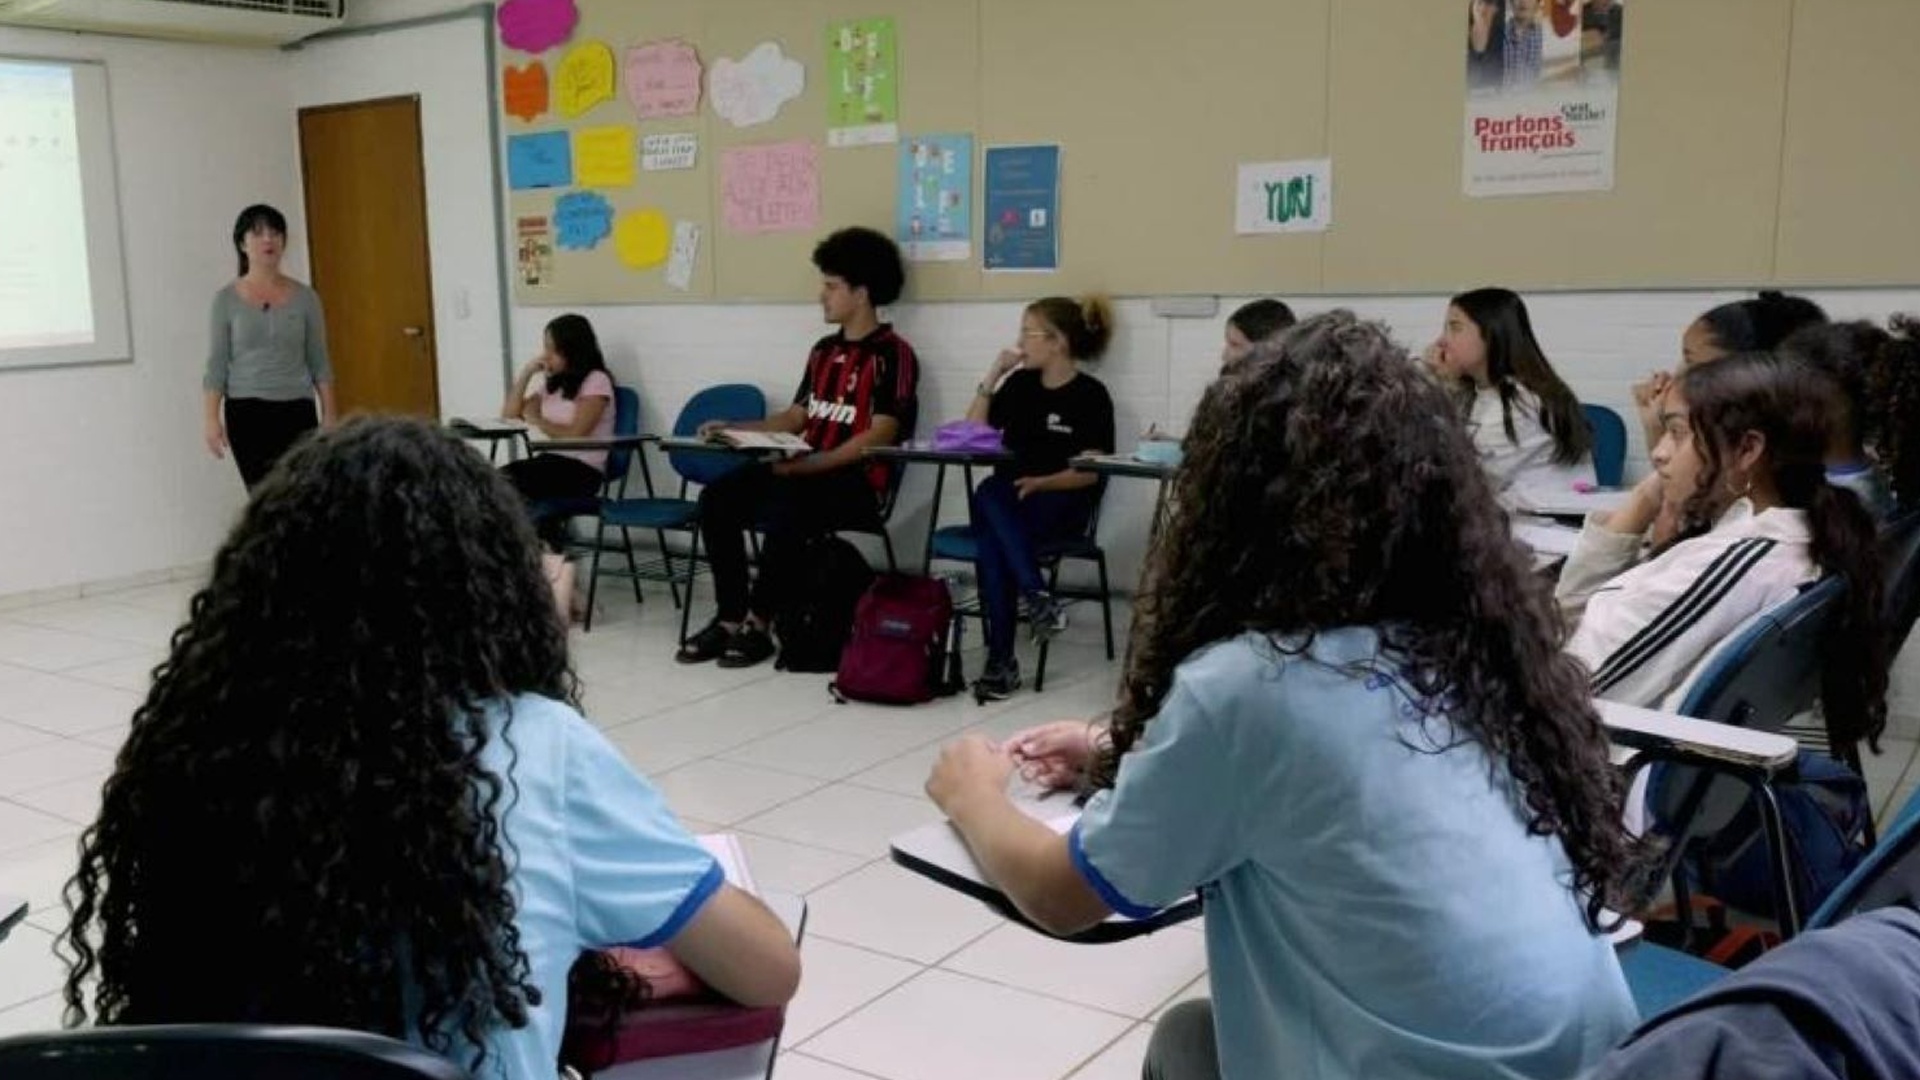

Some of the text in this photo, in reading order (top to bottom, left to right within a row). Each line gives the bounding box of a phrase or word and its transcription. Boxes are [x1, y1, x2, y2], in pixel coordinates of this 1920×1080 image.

[1475, 115, 1563, 137] Parlons
[1481, 131, 1576, 153] français
[808, 392, 858, 426] bwin
